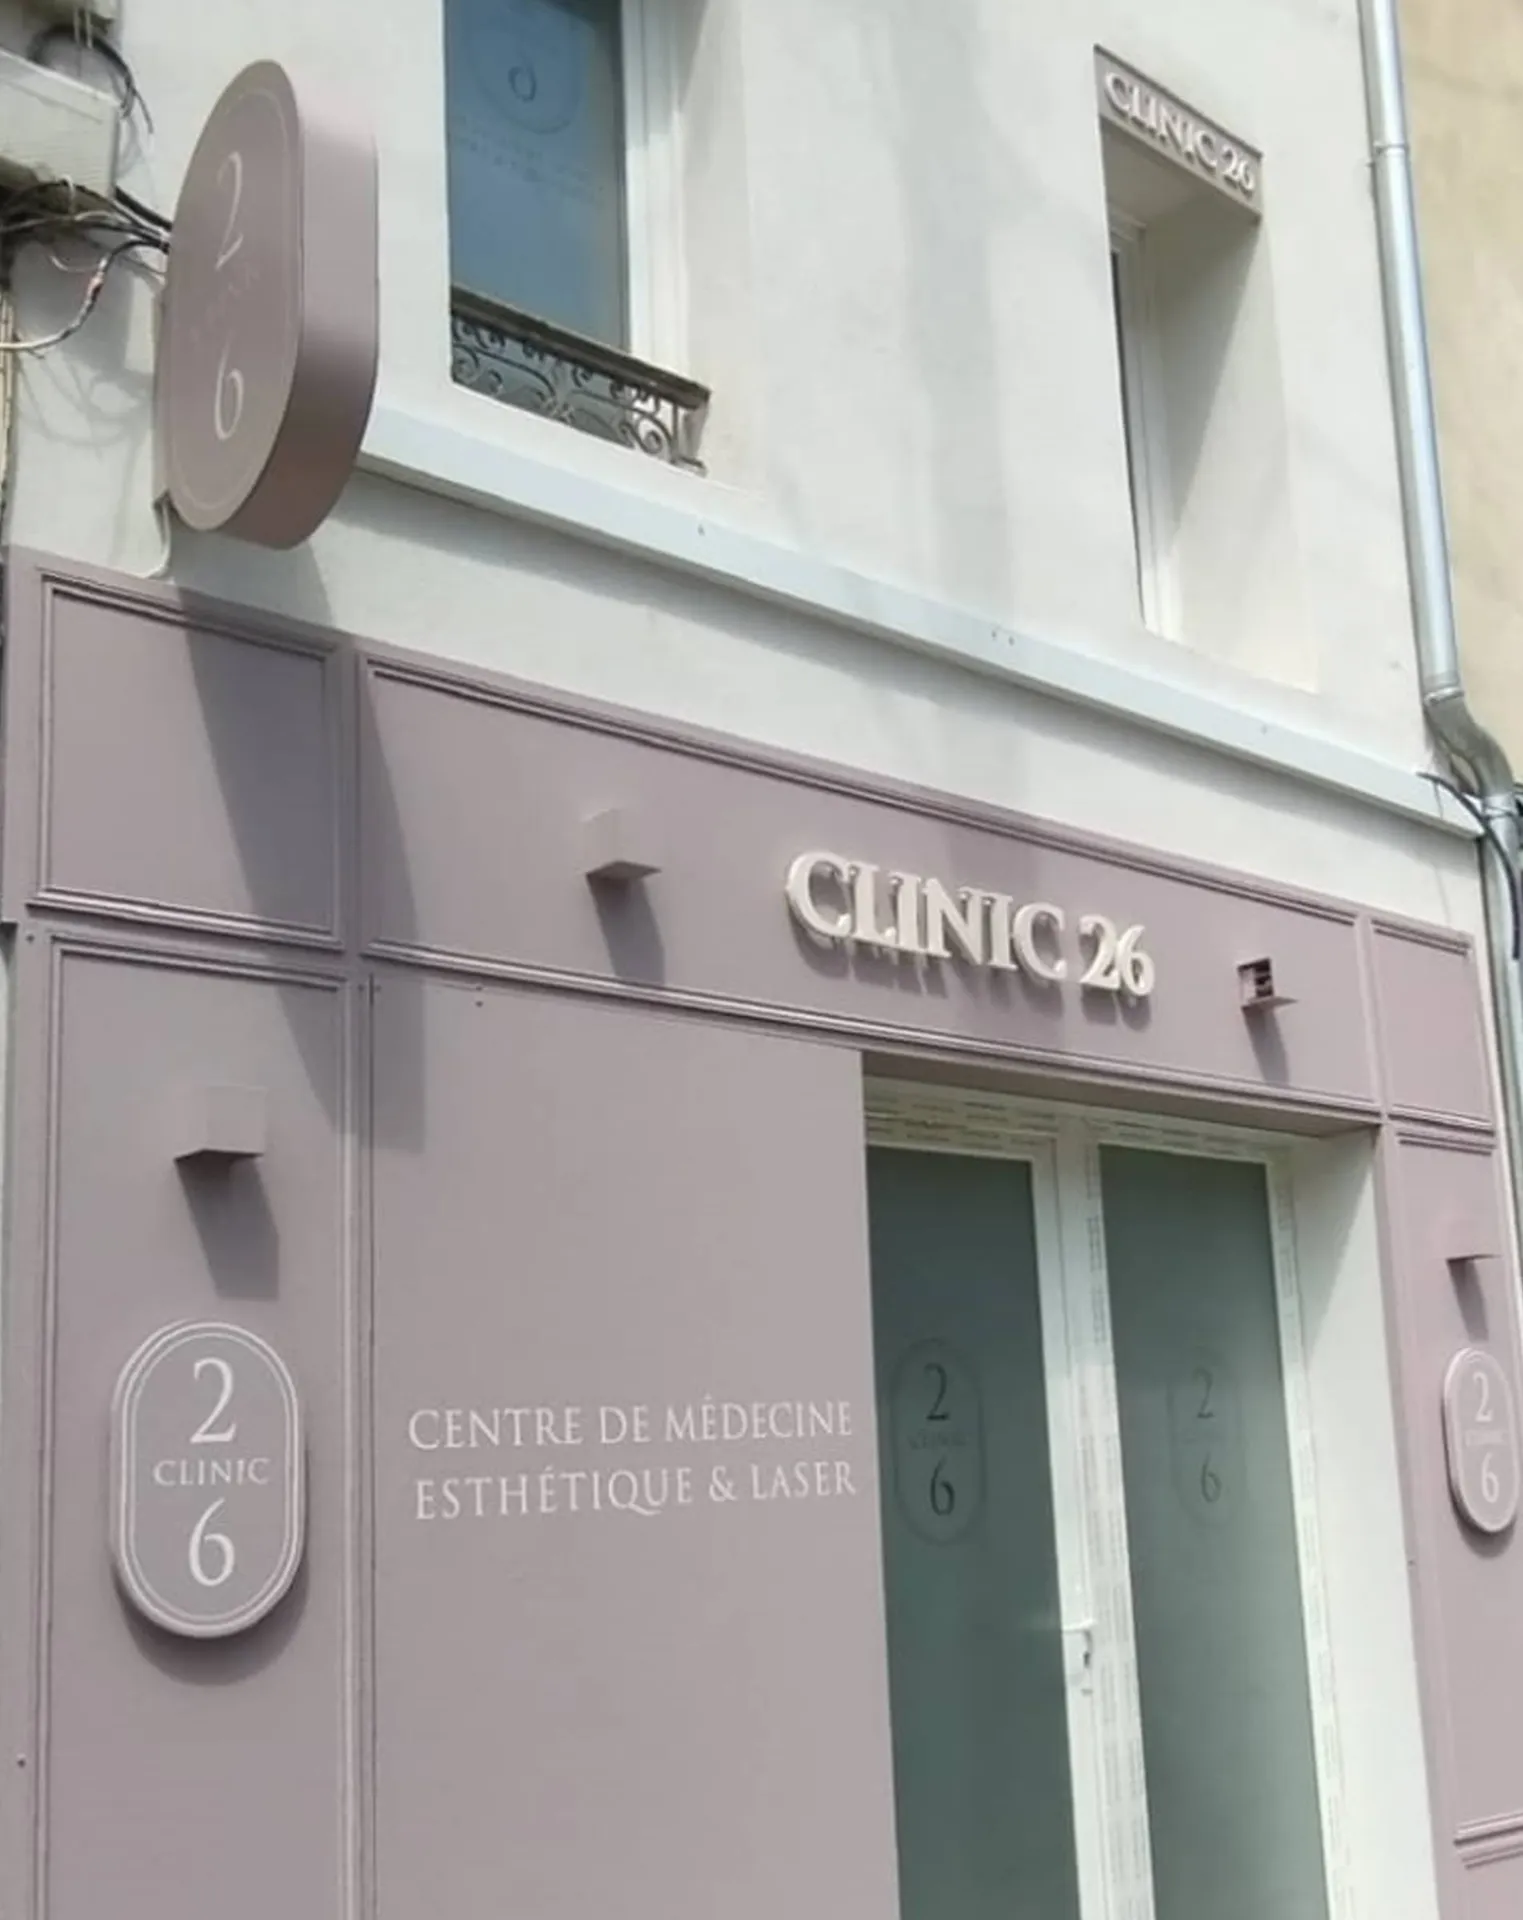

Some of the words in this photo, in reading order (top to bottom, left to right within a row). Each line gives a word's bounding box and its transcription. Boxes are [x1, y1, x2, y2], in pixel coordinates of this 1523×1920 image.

[1105, 72, 1217, 168] CLINIC
[1222, 145, 1255, 190] 26
[216, 151, 244, 271] 2
[214, 329, 244, 440] 6
[785, 851, 1068, 981] CLINIC
[1078, 914, 1155, 996] 26
[190, 1357, 237, 1444] 2
[923, 1362, 949, 1421] 2
[1193, 1367, 1215, 1419] 2
[1473, 1371, 1493, 1422] 2
[408, 1407, 584, 1450] CENTRE
[600, 1404, 652, 1444] DE
[665, 1394, 853, 1442] MÉDECINE
[153, 1457, 270, 1486] CLINIC
[415, 1465, 693, 1520] ESTHÉTIQUE
[708, 1465, 737, 1502] &
[750, 1461, 857, 1500] LASER
[930, 1455, 956, 1516] 6
[1201, 1452, 1222, 1503] 6
[1481, 1452, 1499, 1504] 6
[188, 1498, 236, 1586] 6
